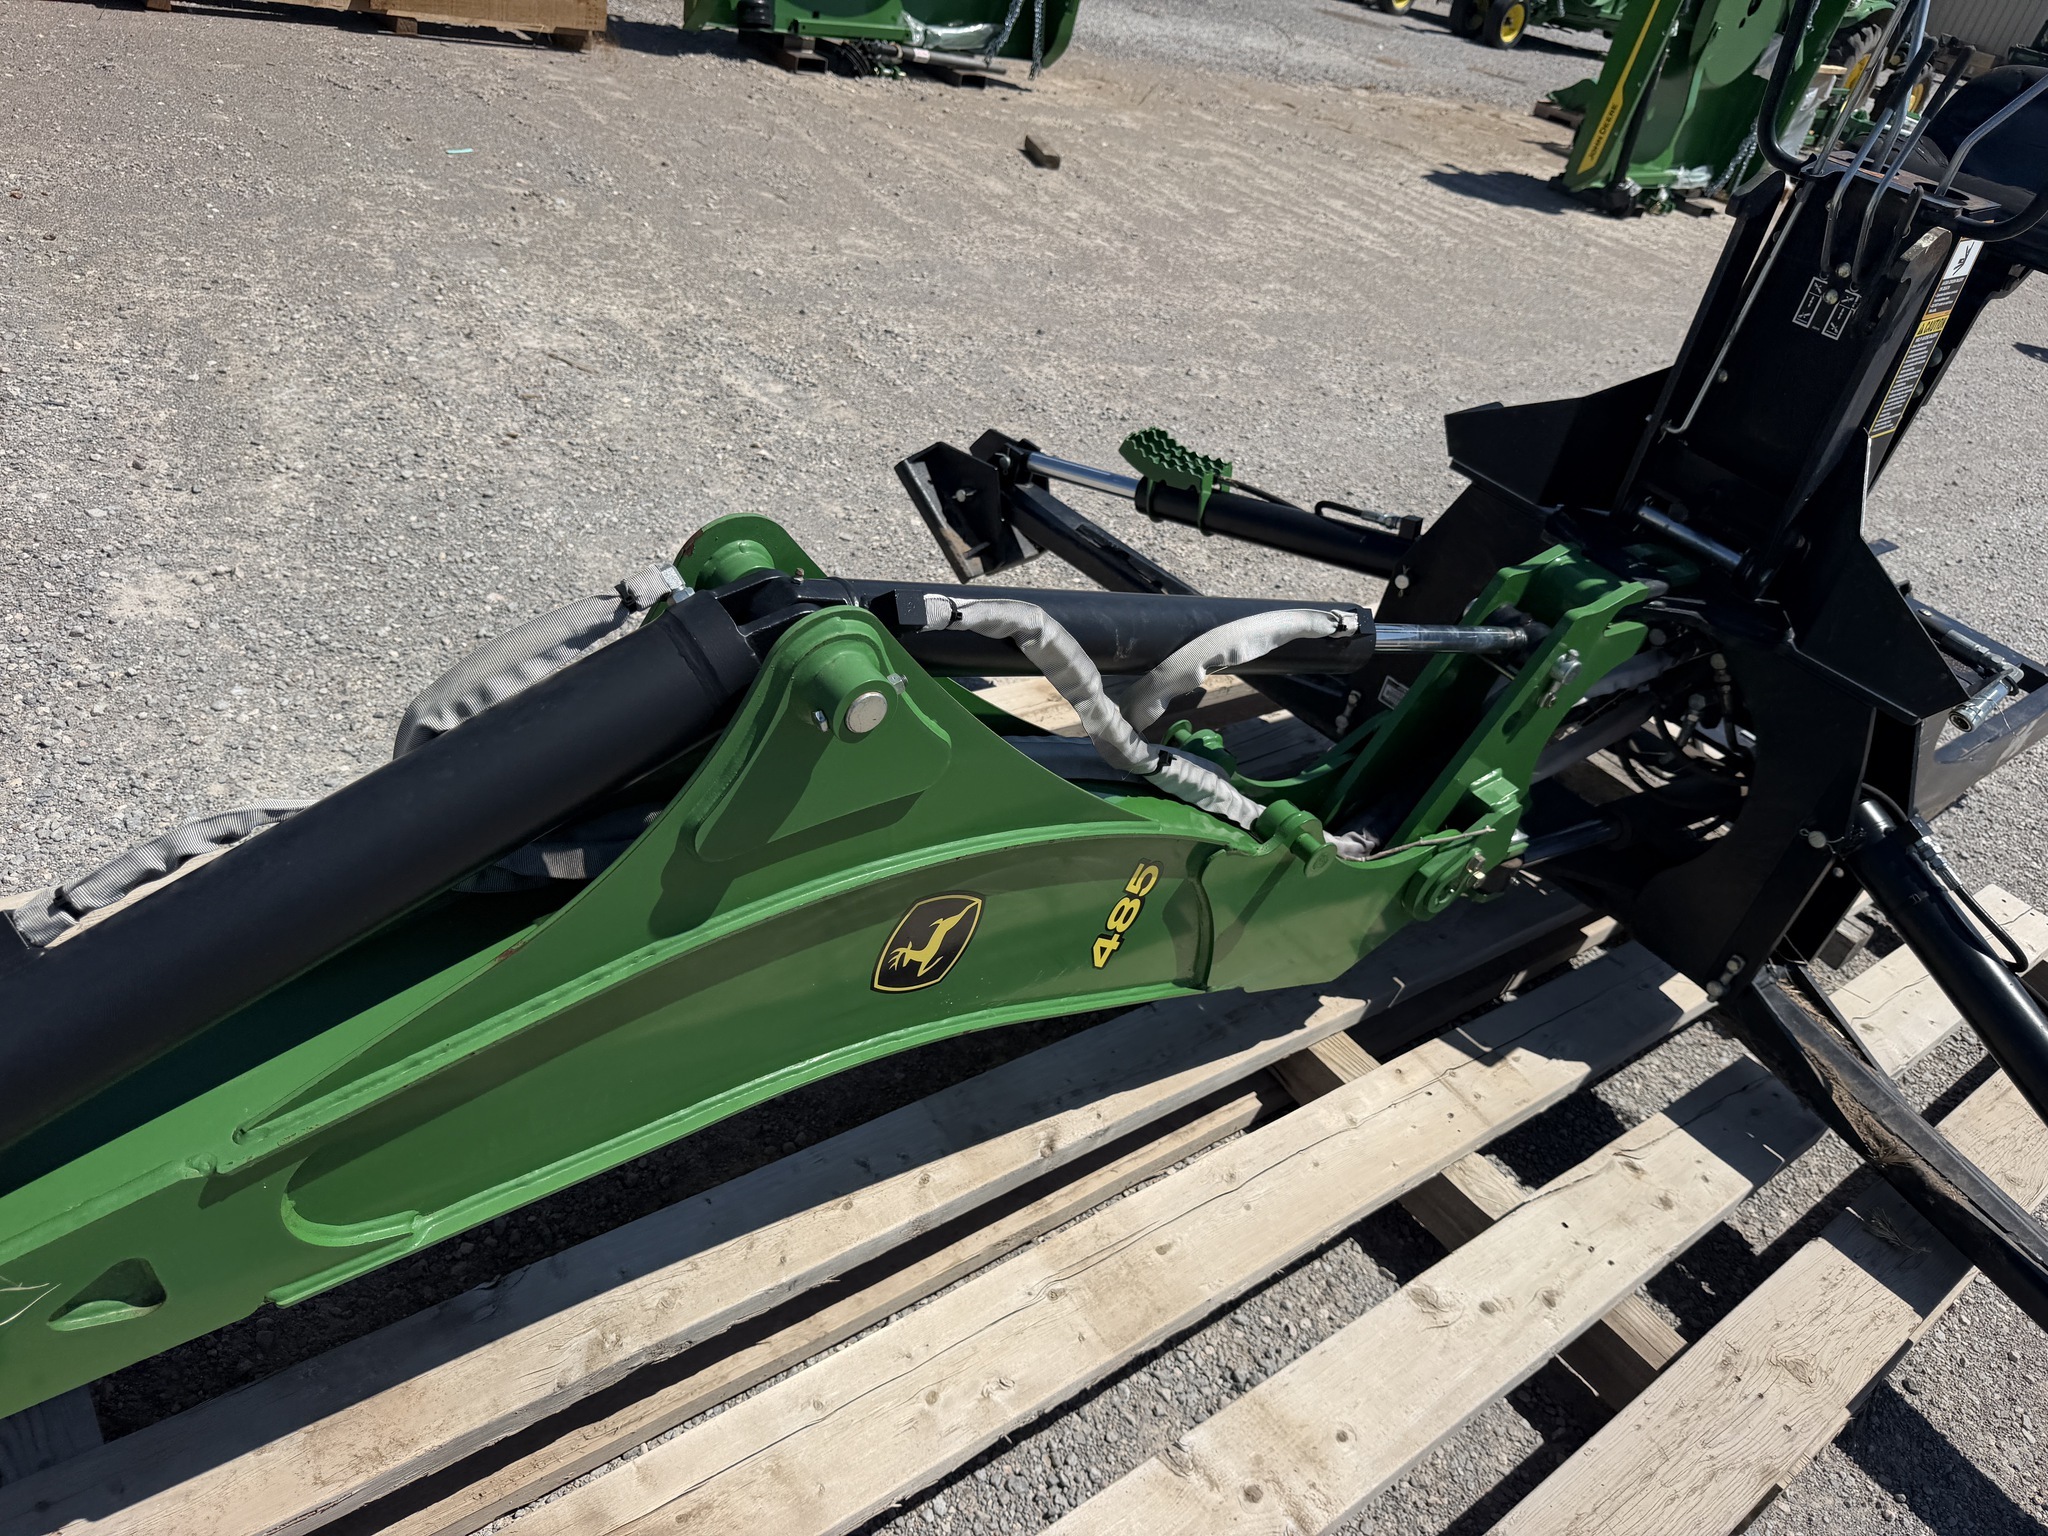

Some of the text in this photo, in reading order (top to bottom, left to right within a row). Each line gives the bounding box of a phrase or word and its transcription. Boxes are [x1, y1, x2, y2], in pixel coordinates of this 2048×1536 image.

[1588, 104, 1619, 161] JOHN DEERE
[1923, 317, 1947, 333] CAUTION
[1092, 862, 1160, 968] 485
